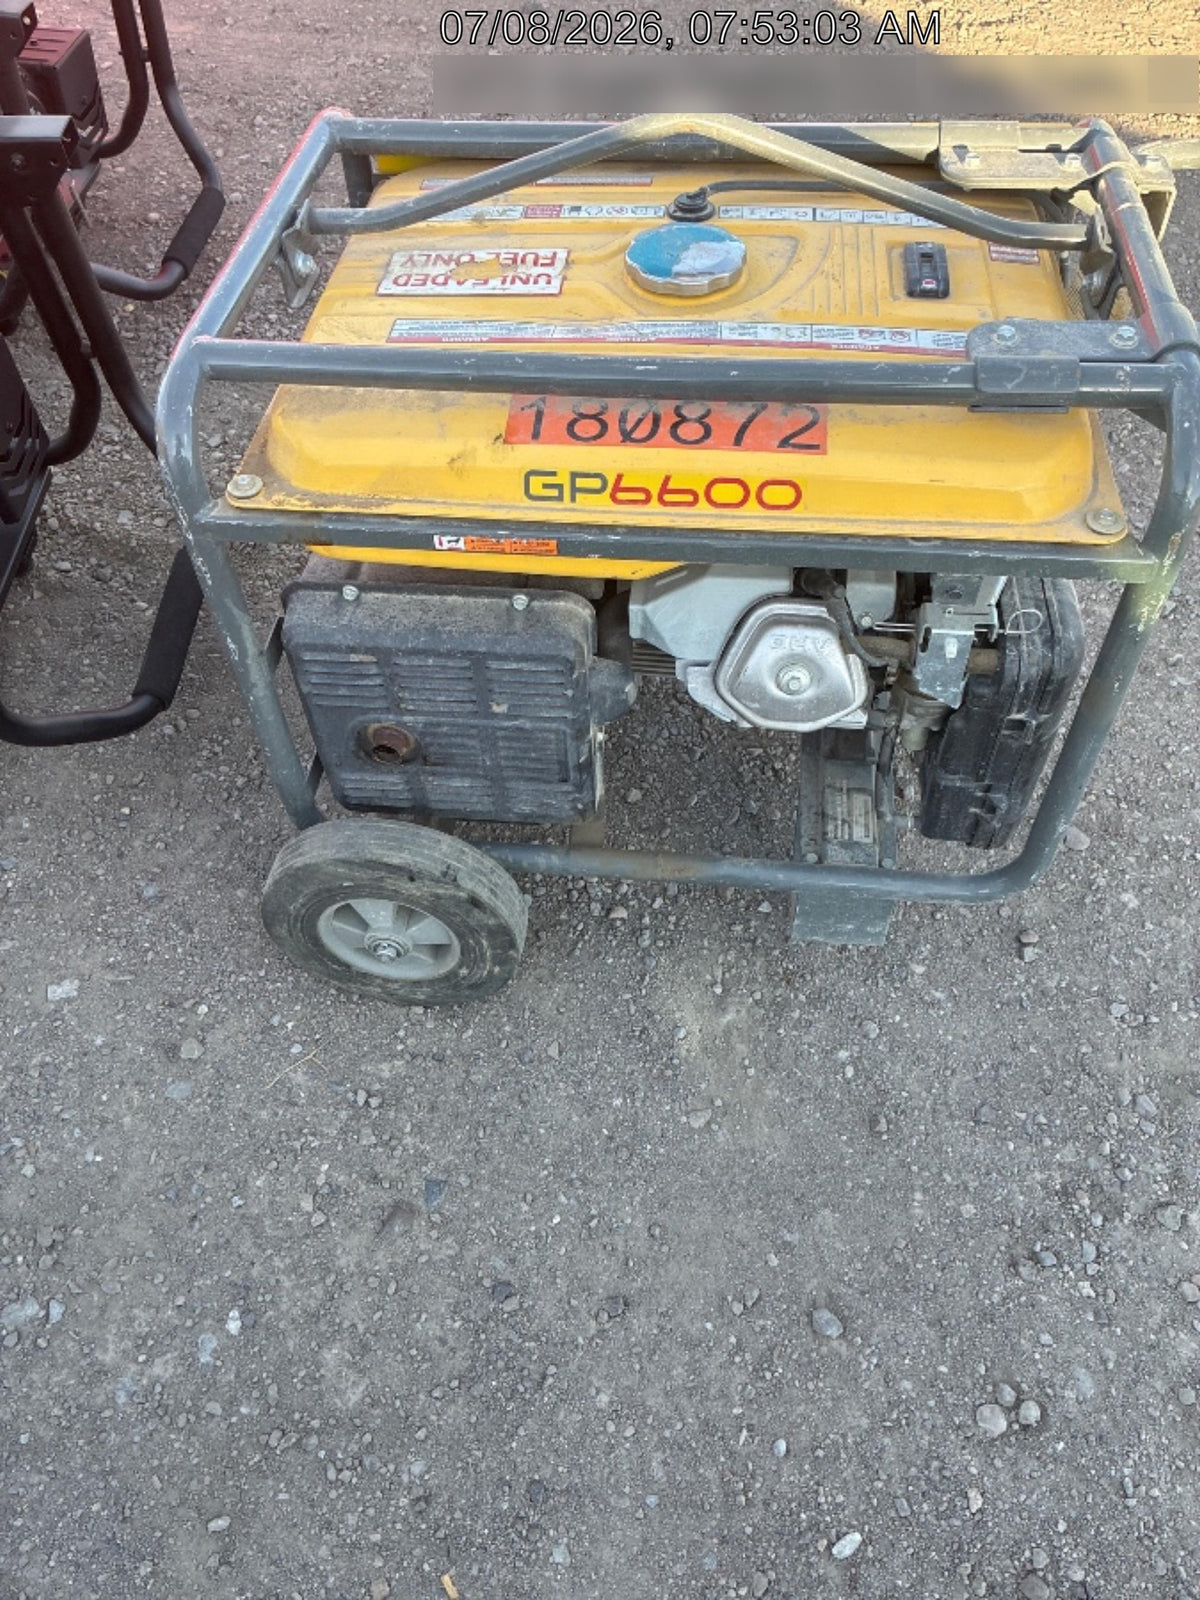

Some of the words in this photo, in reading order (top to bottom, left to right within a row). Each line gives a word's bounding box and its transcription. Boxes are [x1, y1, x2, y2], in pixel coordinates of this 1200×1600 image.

[401, 252, 476, 268] ONLY
[520, 396, 821, 450] 180872
[523, 469, 803, 511] GP6600
